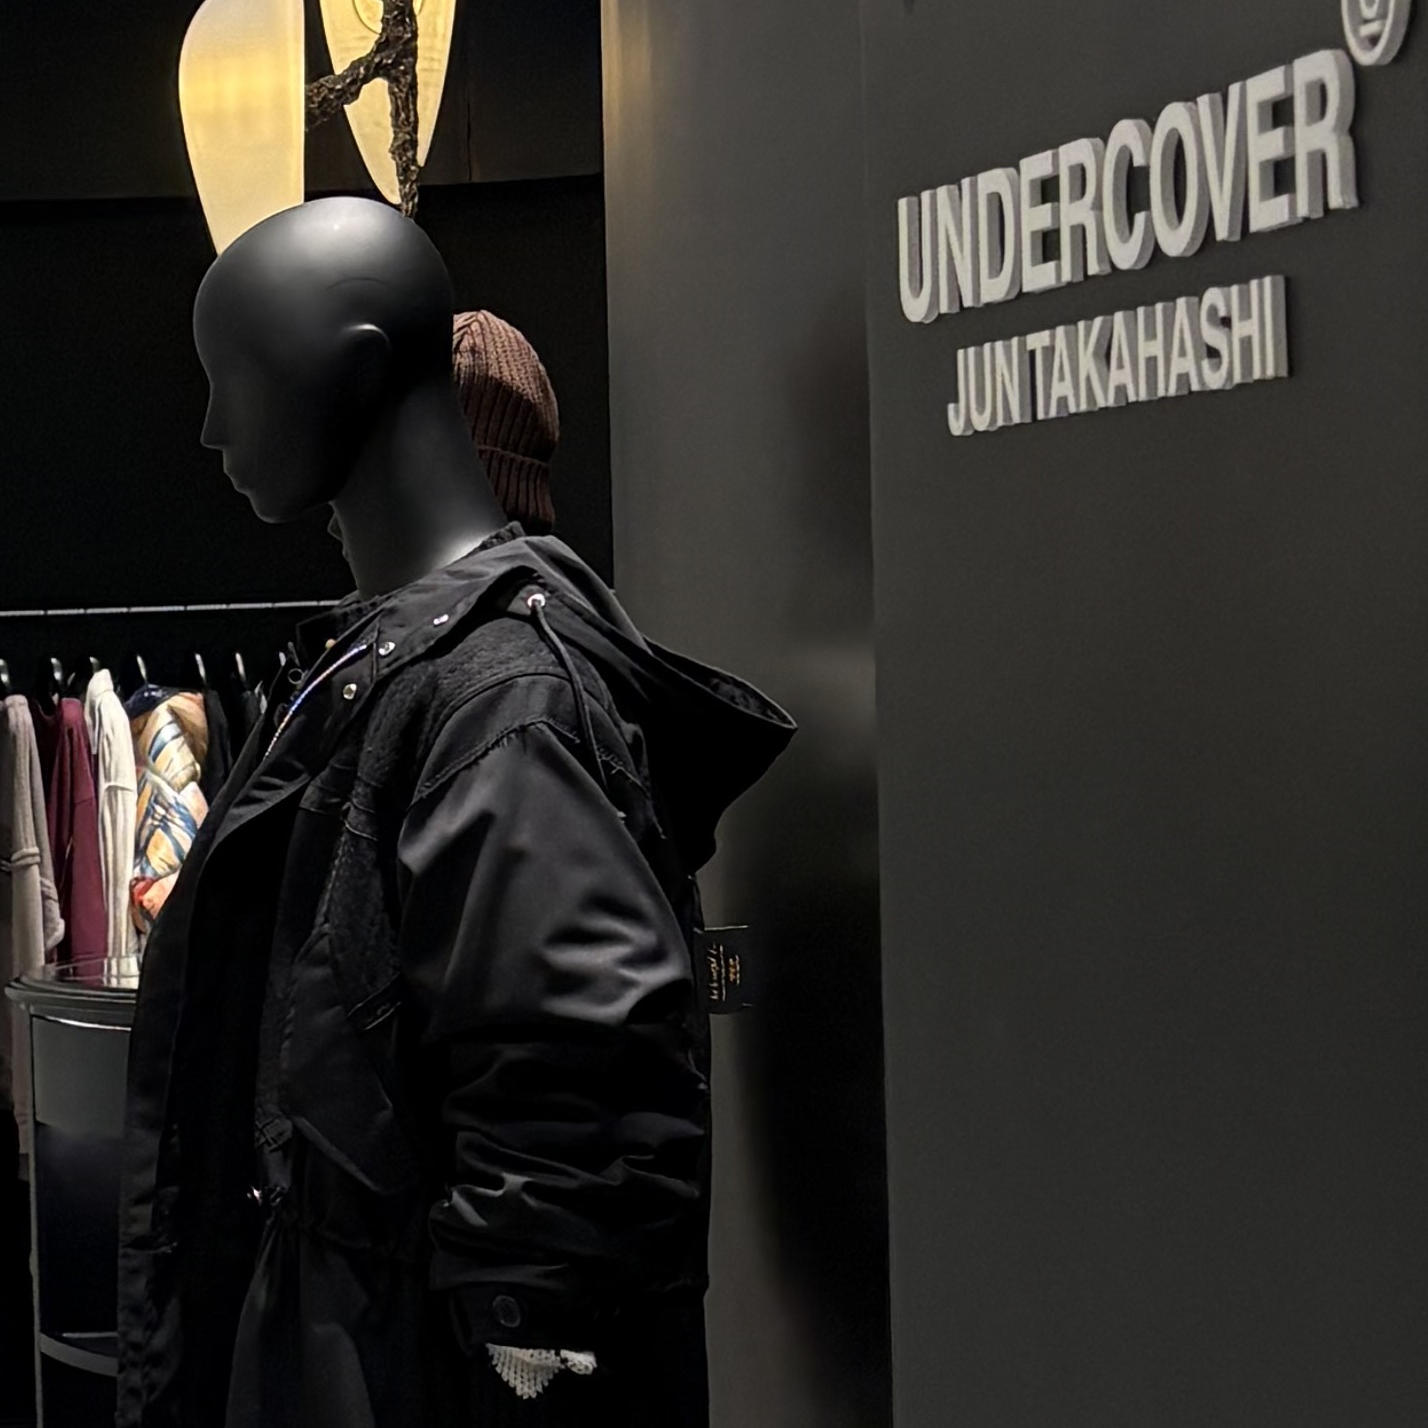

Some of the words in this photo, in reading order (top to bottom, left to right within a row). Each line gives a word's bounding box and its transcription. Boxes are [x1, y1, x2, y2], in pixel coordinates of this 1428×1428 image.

[898, 49, 1358, 323] UNDERCOVER
[948, 336, 1032, 436] JUN
[1026, 275, 1288, 420] TAKAHASHI
